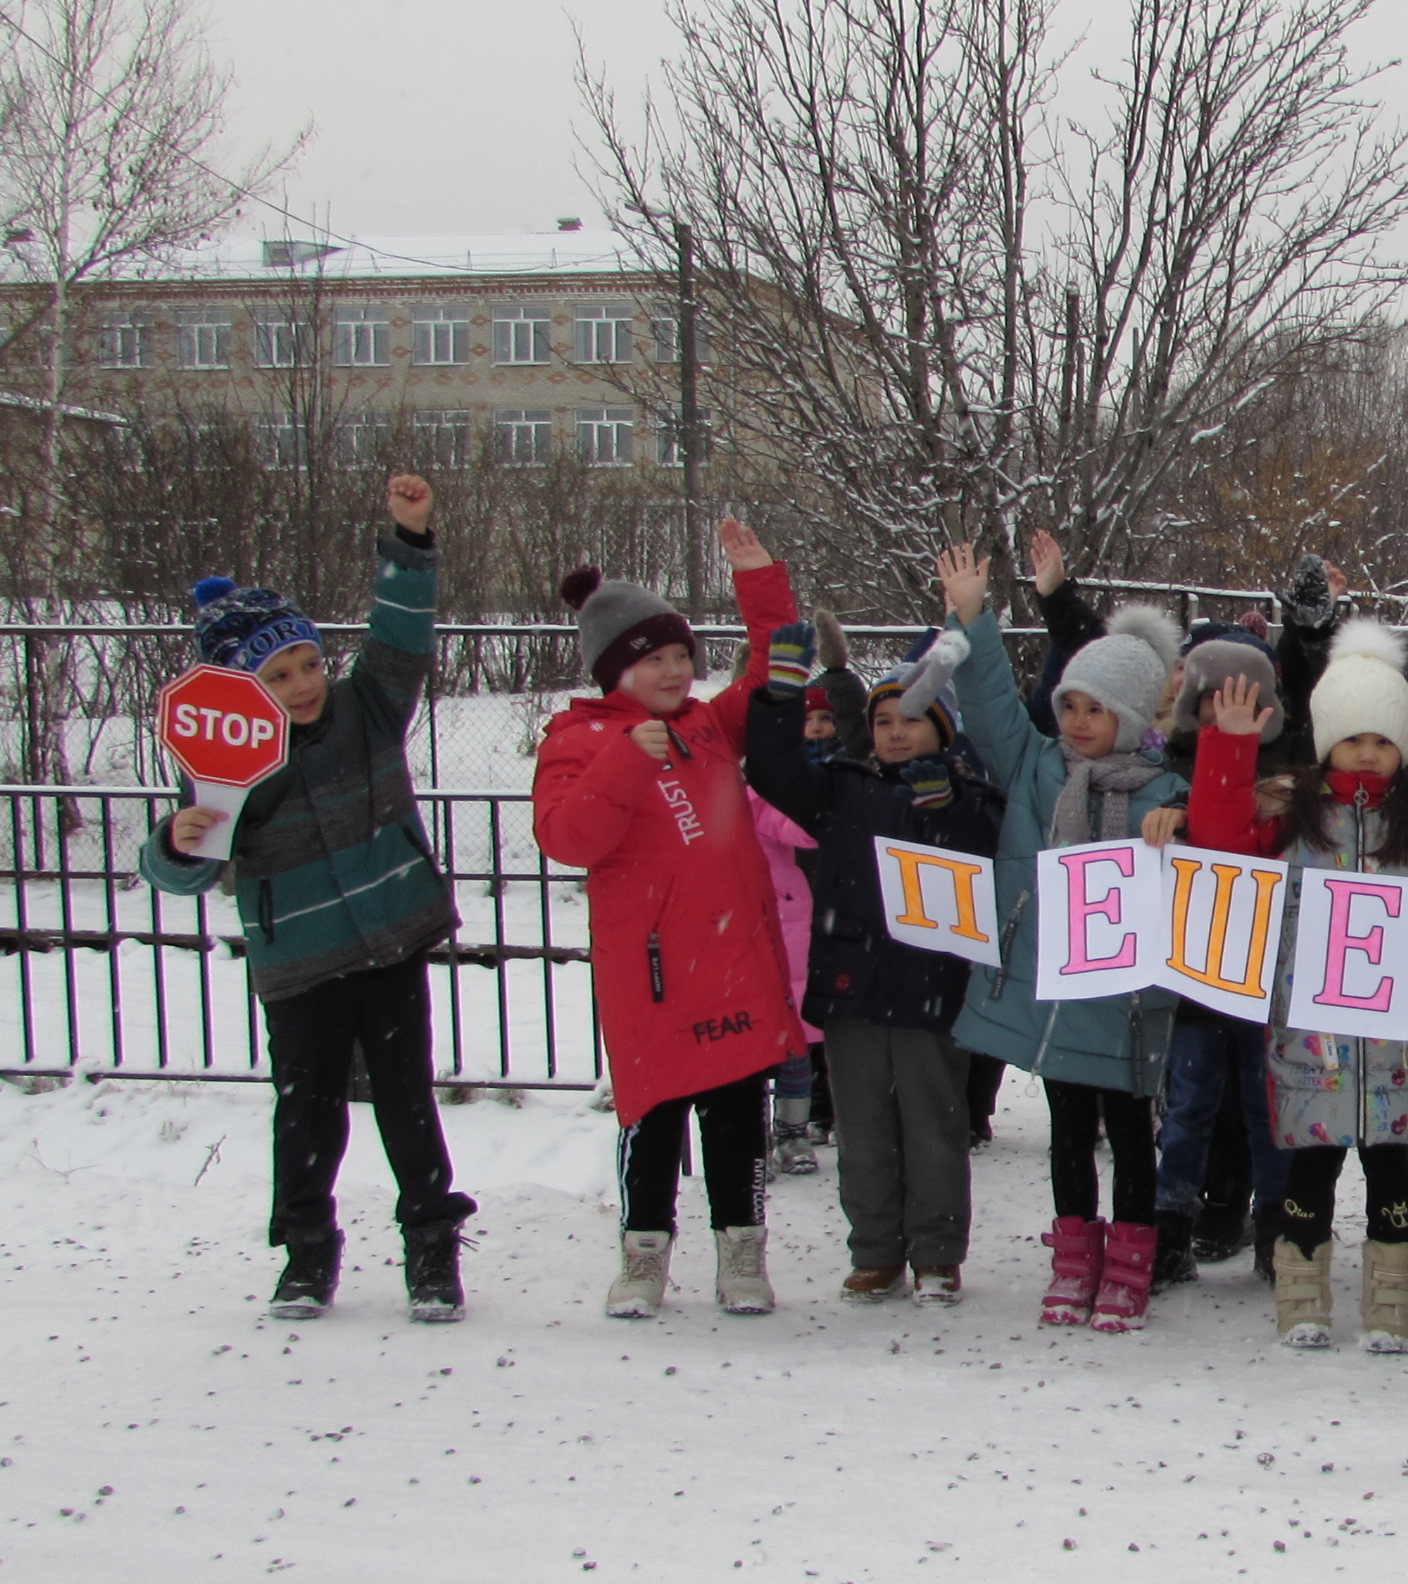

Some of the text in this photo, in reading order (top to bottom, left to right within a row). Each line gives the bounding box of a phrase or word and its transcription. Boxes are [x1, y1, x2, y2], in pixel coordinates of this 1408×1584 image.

[175, 704, 275, 749] STOP
[657, 780, 705, 846] TRUST
[692, 1010, 753, 1044] FEAR
